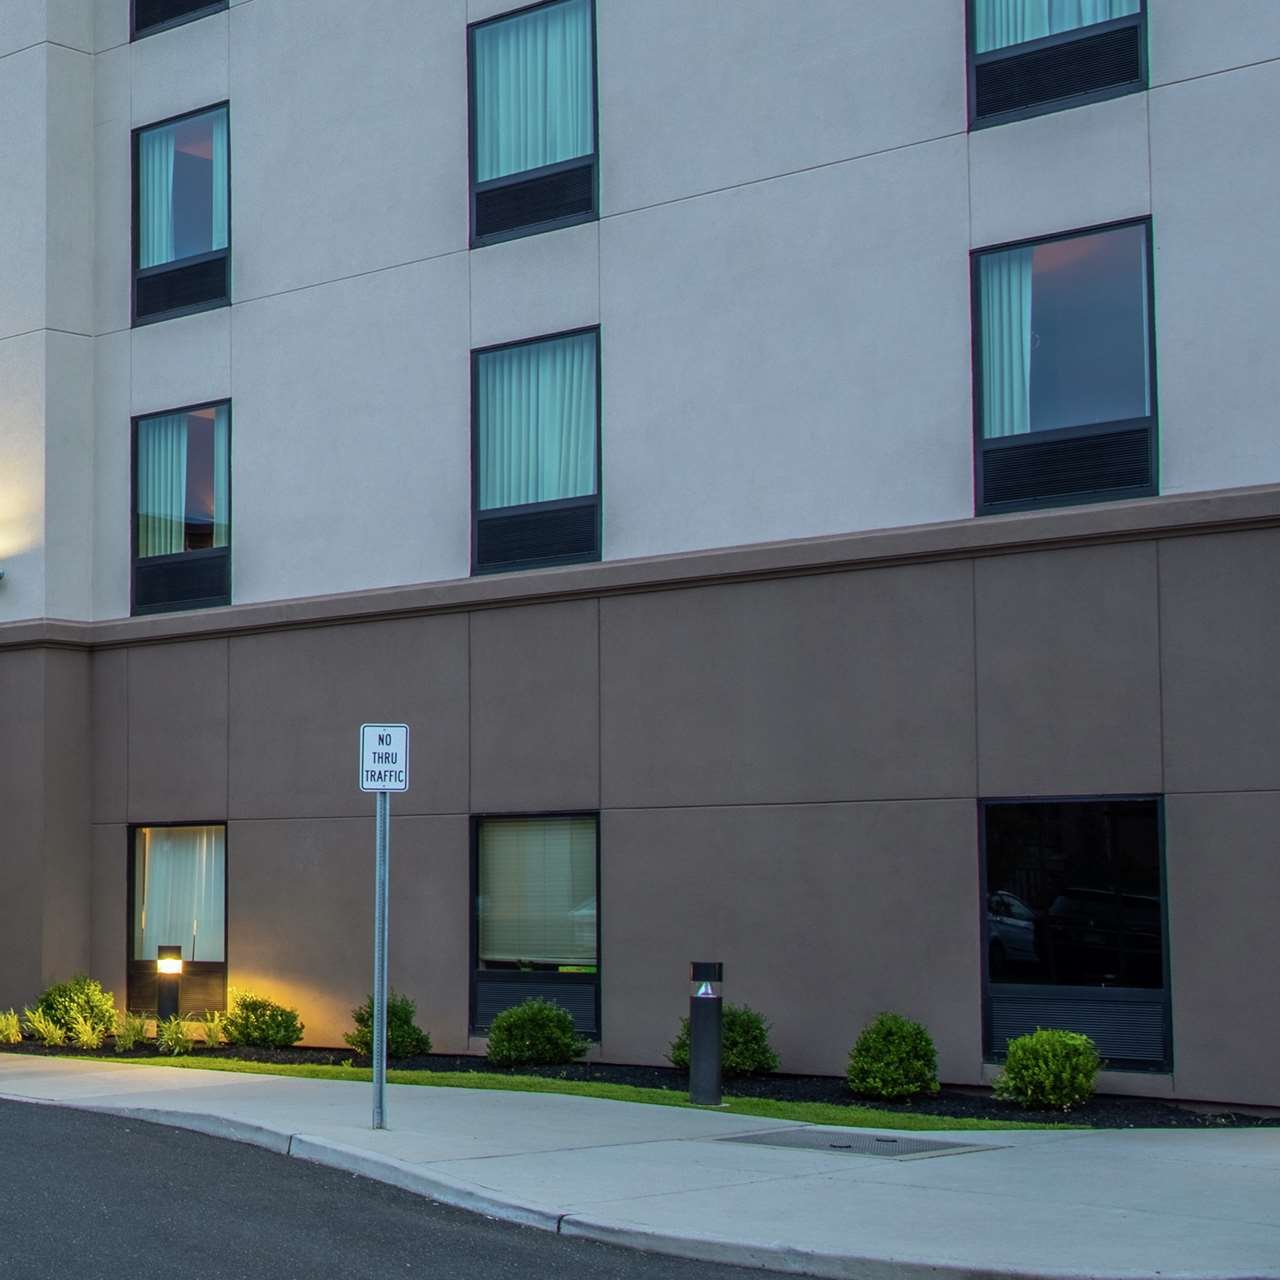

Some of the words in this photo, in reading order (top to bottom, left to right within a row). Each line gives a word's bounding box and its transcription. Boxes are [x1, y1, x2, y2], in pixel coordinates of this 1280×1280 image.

[378, 733, 392, 746] NO
[372, 751, 398, 765] THRU
[365, 770, 404, 783] TRAFFIC
